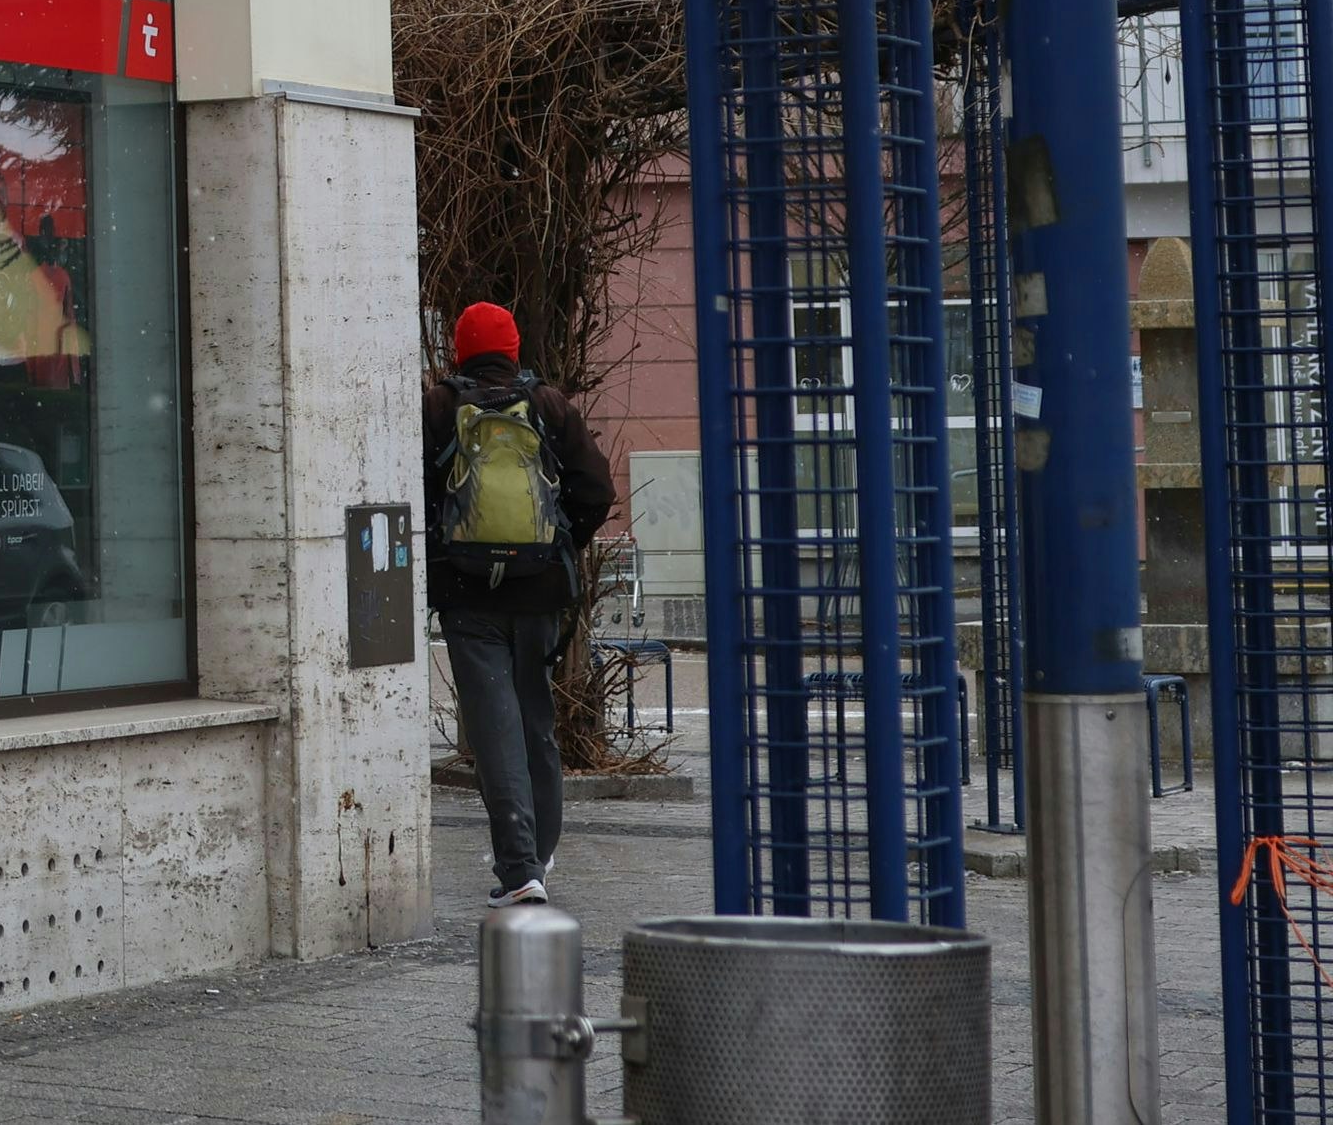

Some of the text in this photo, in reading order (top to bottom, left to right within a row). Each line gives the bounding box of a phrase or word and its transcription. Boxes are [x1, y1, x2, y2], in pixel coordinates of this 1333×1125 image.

[142, 13, 159, 57] t
[12, 472, 45, 492] DABEI!
[1, 495, 43, 518] SPÜRST.
